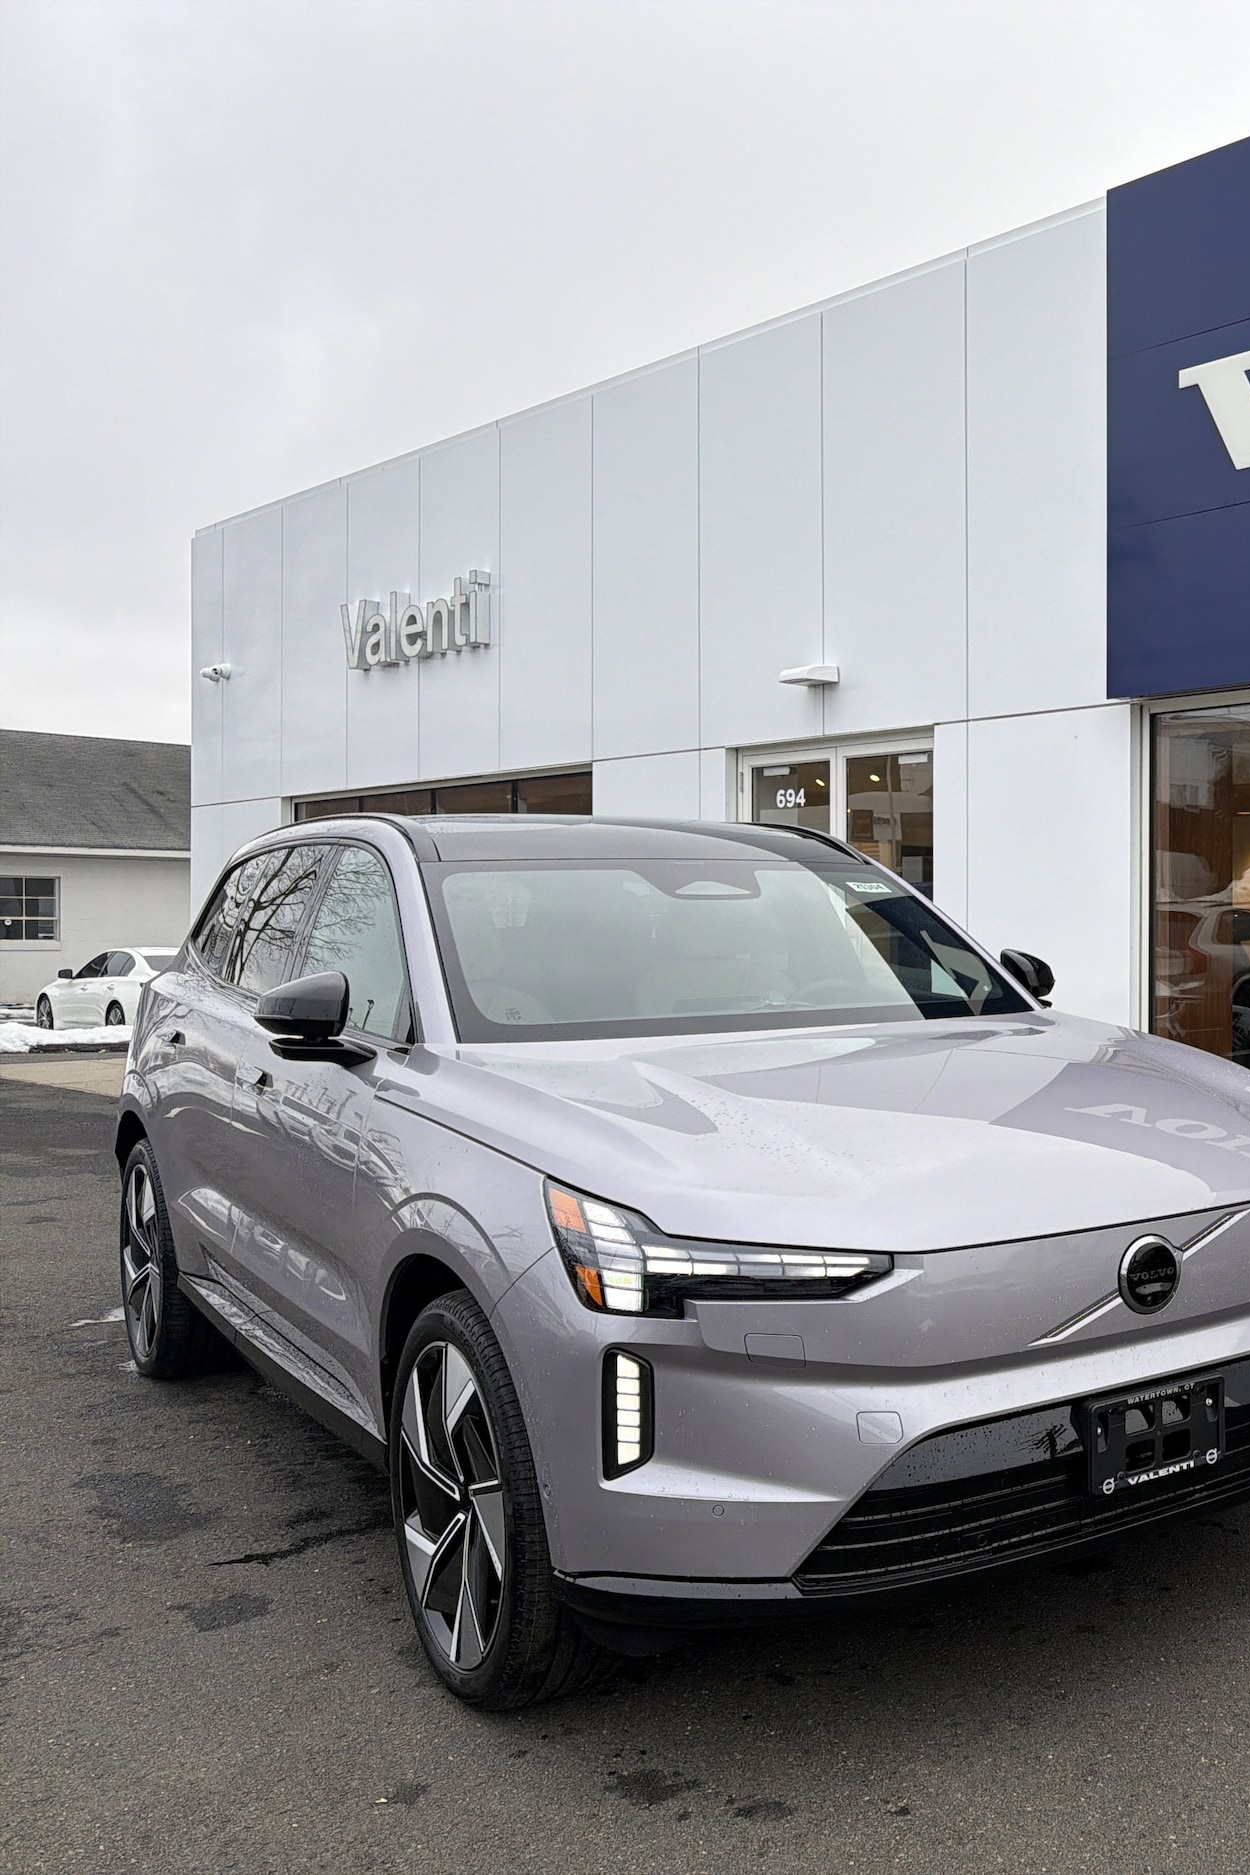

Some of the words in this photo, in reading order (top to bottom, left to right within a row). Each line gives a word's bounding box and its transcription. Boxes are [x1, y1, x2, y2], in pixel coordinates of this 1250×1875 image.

[340, 569, 491, 671] Valenti
[776, 788, 806, 808] 694
[1184, 1382, 1195, 1391] CT
[1127, 1460, 1195, 1486] VALENTI
